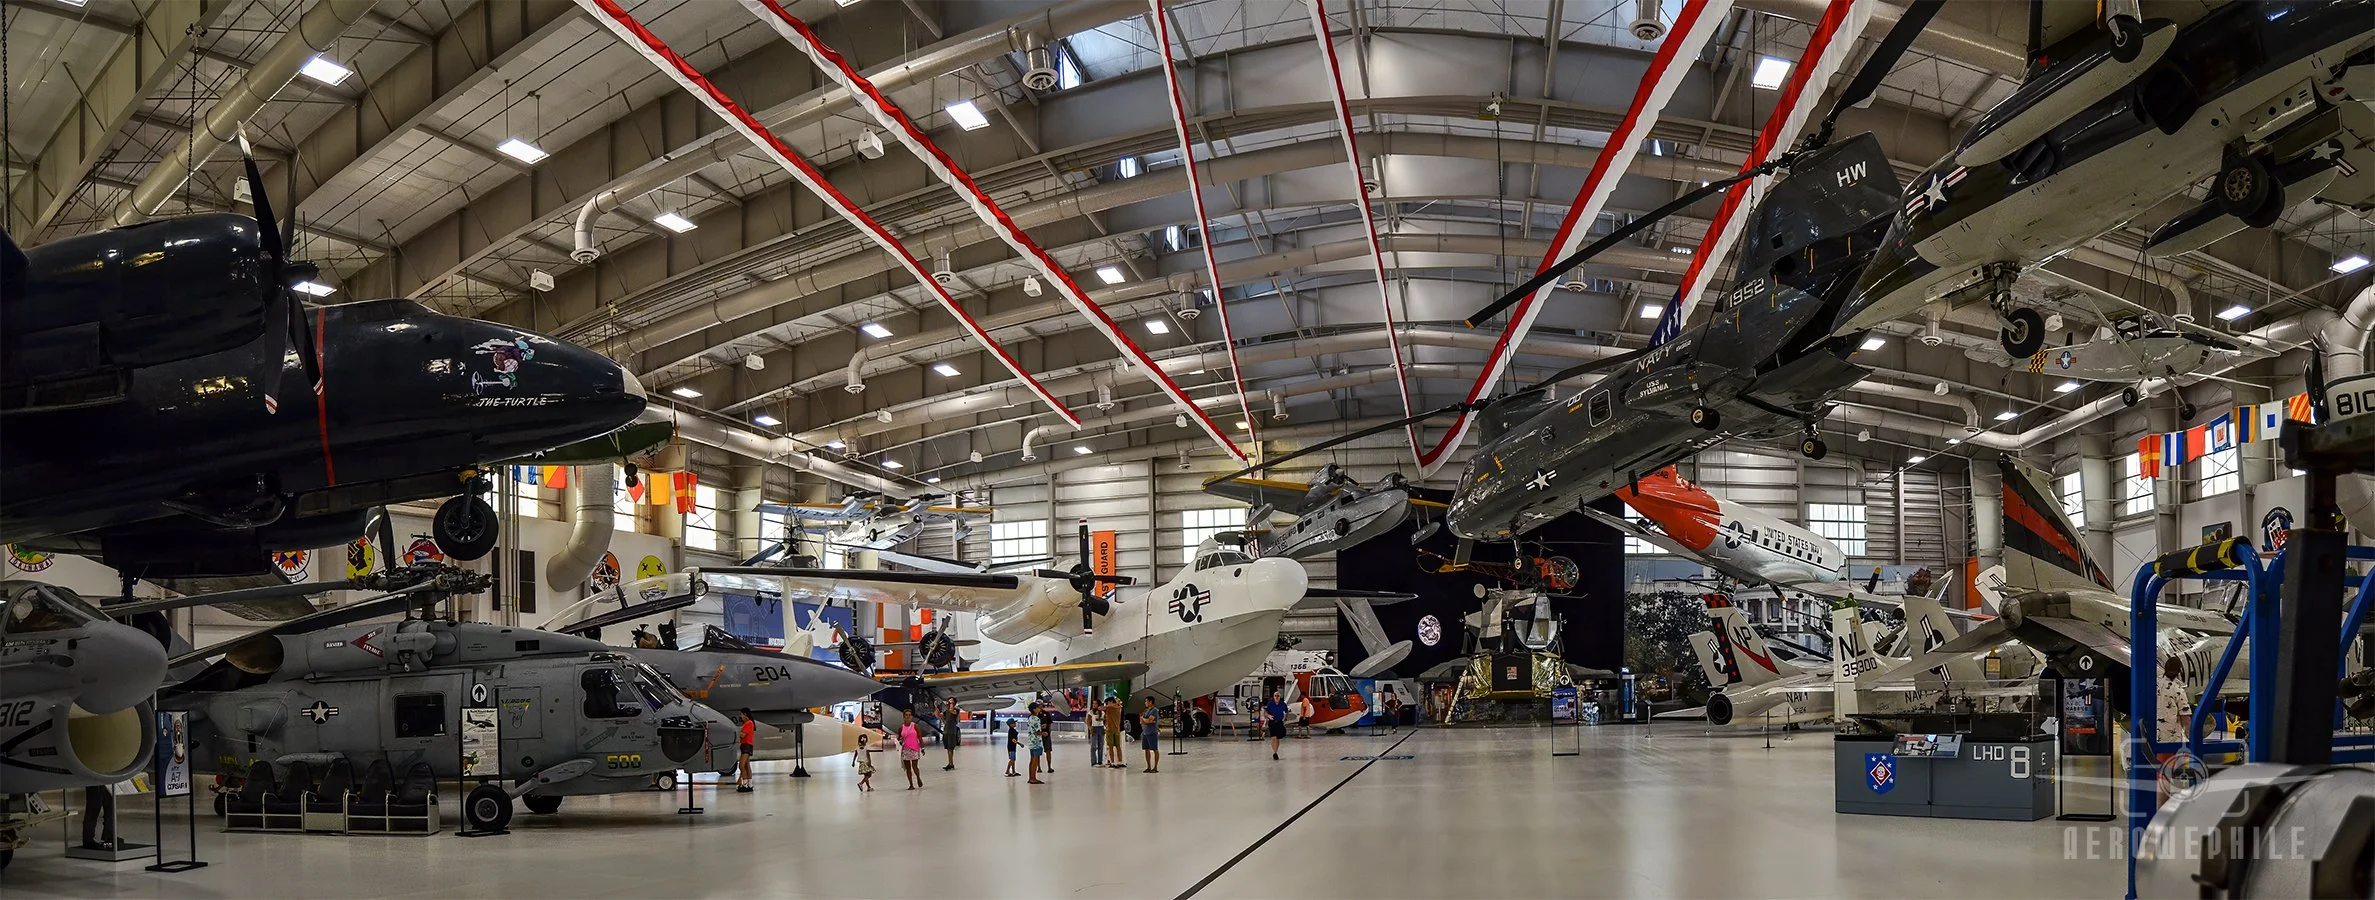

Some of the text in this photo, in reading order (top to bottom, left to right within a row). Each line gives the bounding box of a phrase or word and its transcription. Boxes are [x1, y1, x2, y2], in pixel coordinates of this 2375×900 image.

[1836, 161, 1867, 188] HW
[1729, 277, 1765, 308] 1952
[1636, 344, 1673, 373] NAVY
[1639, 382, 1669, 398] SYLVANIA
[1646, 379, 1660, 388] USS
[479, 396, 549, 407] THE TURTLE
[1763, 526, 1786, 544] UNITED
[1787, 534, 1809, 552] STATES
[1100, 541, 1109, 575] GUARD
[1732, 626, 1752, 650] NP
[1838, 631, 1867, 662] NL
[1019, 650, 1040, 667] NAVY
[1842, 657, 1878, 677] 35300
[753, 665, 792, 682] 204
[0, 700, 36, 728] 312
[607, 753, 641, 770] 500
[1973, 745, 2005, 761] LHD
[2010, 745, 2031, 779] 8
